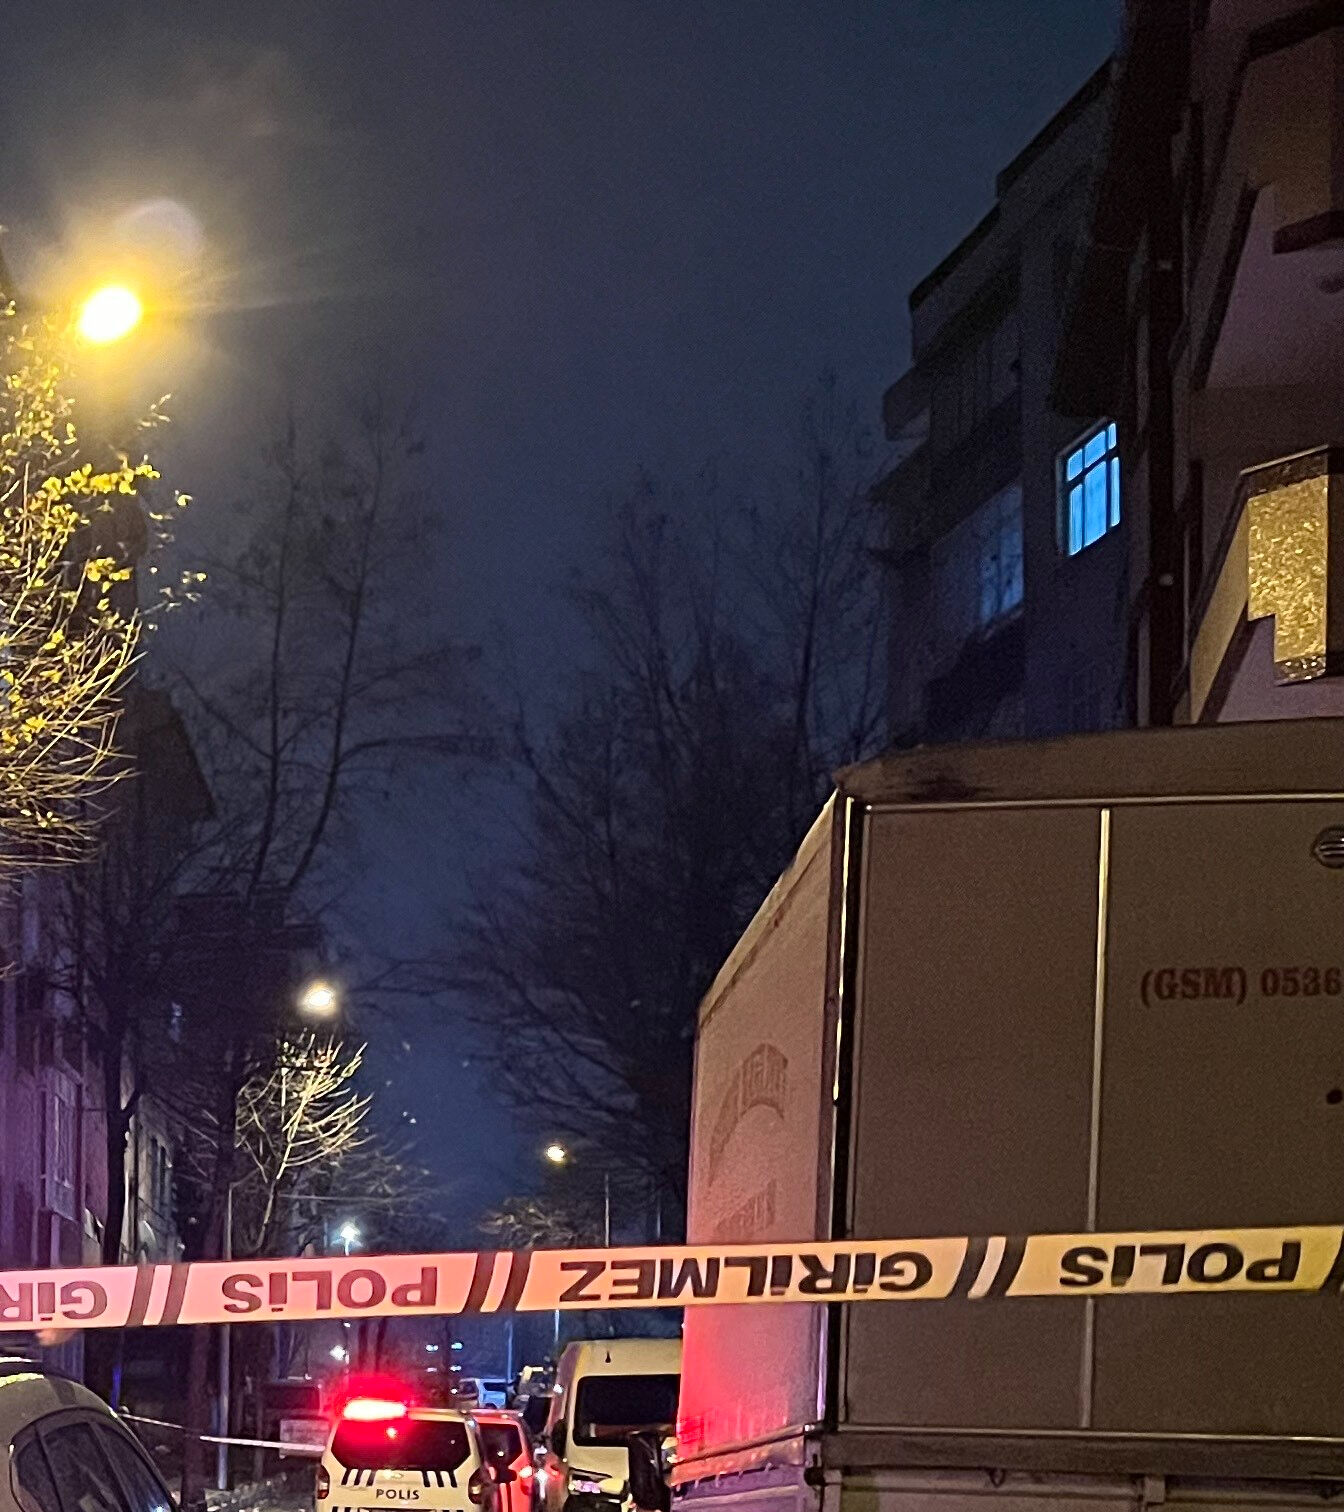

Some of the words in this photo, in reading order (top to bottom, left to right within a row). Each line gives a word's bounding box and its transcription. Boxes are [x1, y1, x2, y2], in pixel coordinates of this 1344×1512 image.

[1141, 966, 1247, 1008] (GSM)
[221, 1266, 438, 1313] POLİS
[559, 1251, 933, 1301] GİRİLMEZ
